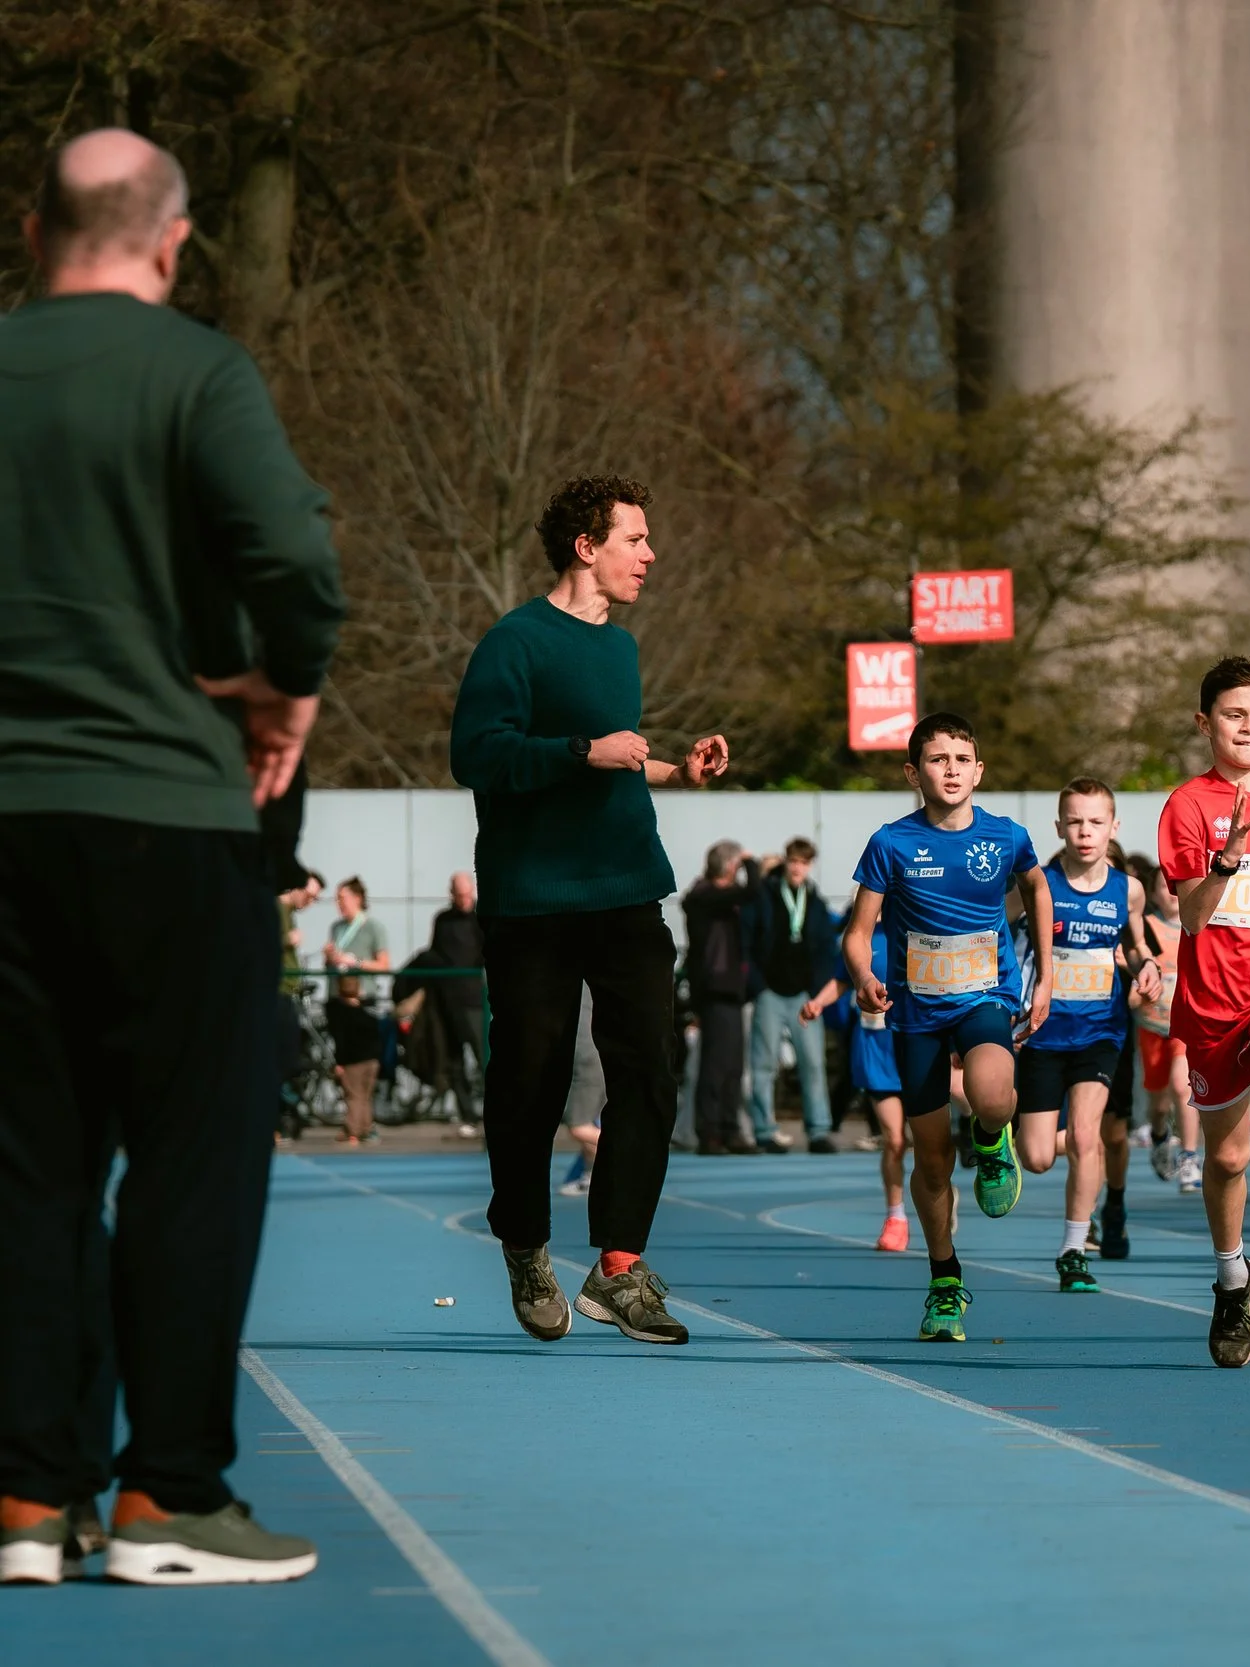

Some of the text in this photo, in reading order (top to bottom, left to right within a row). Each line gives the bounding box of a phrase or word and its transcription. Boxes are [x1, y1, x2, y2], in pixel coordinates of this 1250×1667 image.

[916, 576, 1002, 608] START
[855, 651, 912, 685] WC
[965, 841, 1002, 858] VACBL
[1096, 901, 1118, 911] ACHL
[1069, 920, 1122, 936] runners'
[969, 935, 993, 945] KIDS
[1067, 930, 1090, 944] lab
[912, 949, 992, 982] 7053
